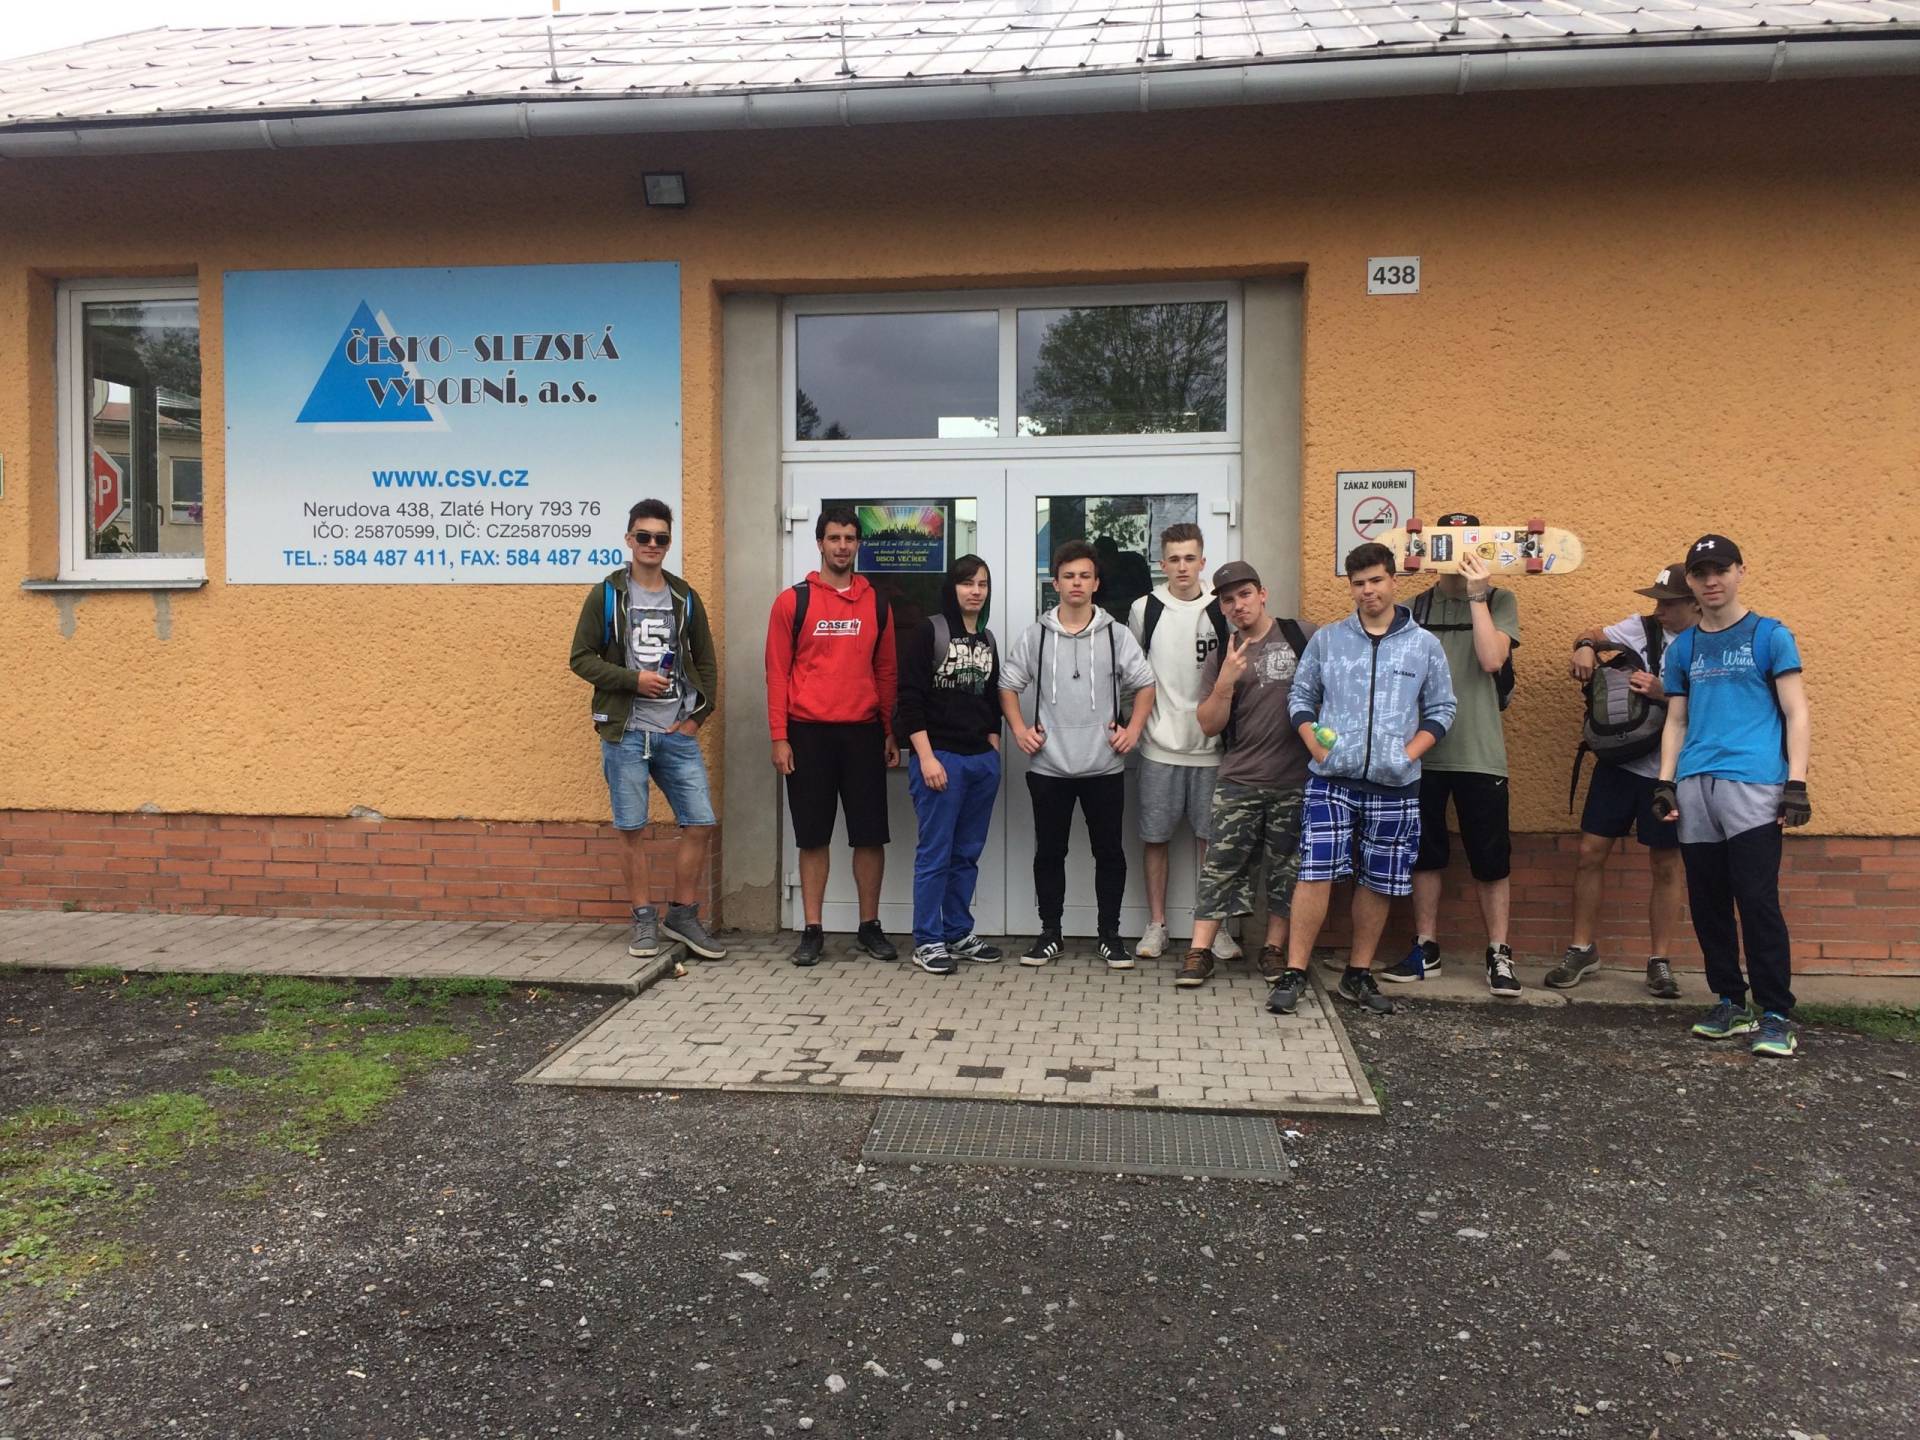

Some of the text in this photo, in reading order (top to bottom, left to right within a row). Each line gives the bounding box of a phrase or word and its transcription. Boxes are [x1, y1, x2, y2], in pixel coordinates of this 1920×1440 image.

[1372, 265, 1416, 285] 438
[366, 369, 598, 408] VÝROBNÍ, a.s.
[372, 469, 529, 488] www.csv.cz
[1343, 478, 1407, 490] ZÁKAZ KOUŘENÍ
[303, 499, 601, 520] Nerudova 438, Zlaté Hory 793 76
[313, 520, 592, 540] IČO: 25870599, DIČ: CZ25870599
[283, 548, 623, 569] TEL.: 584 487 411, FAX: 584 487 430
[818, 621, 848, 629] CASE
